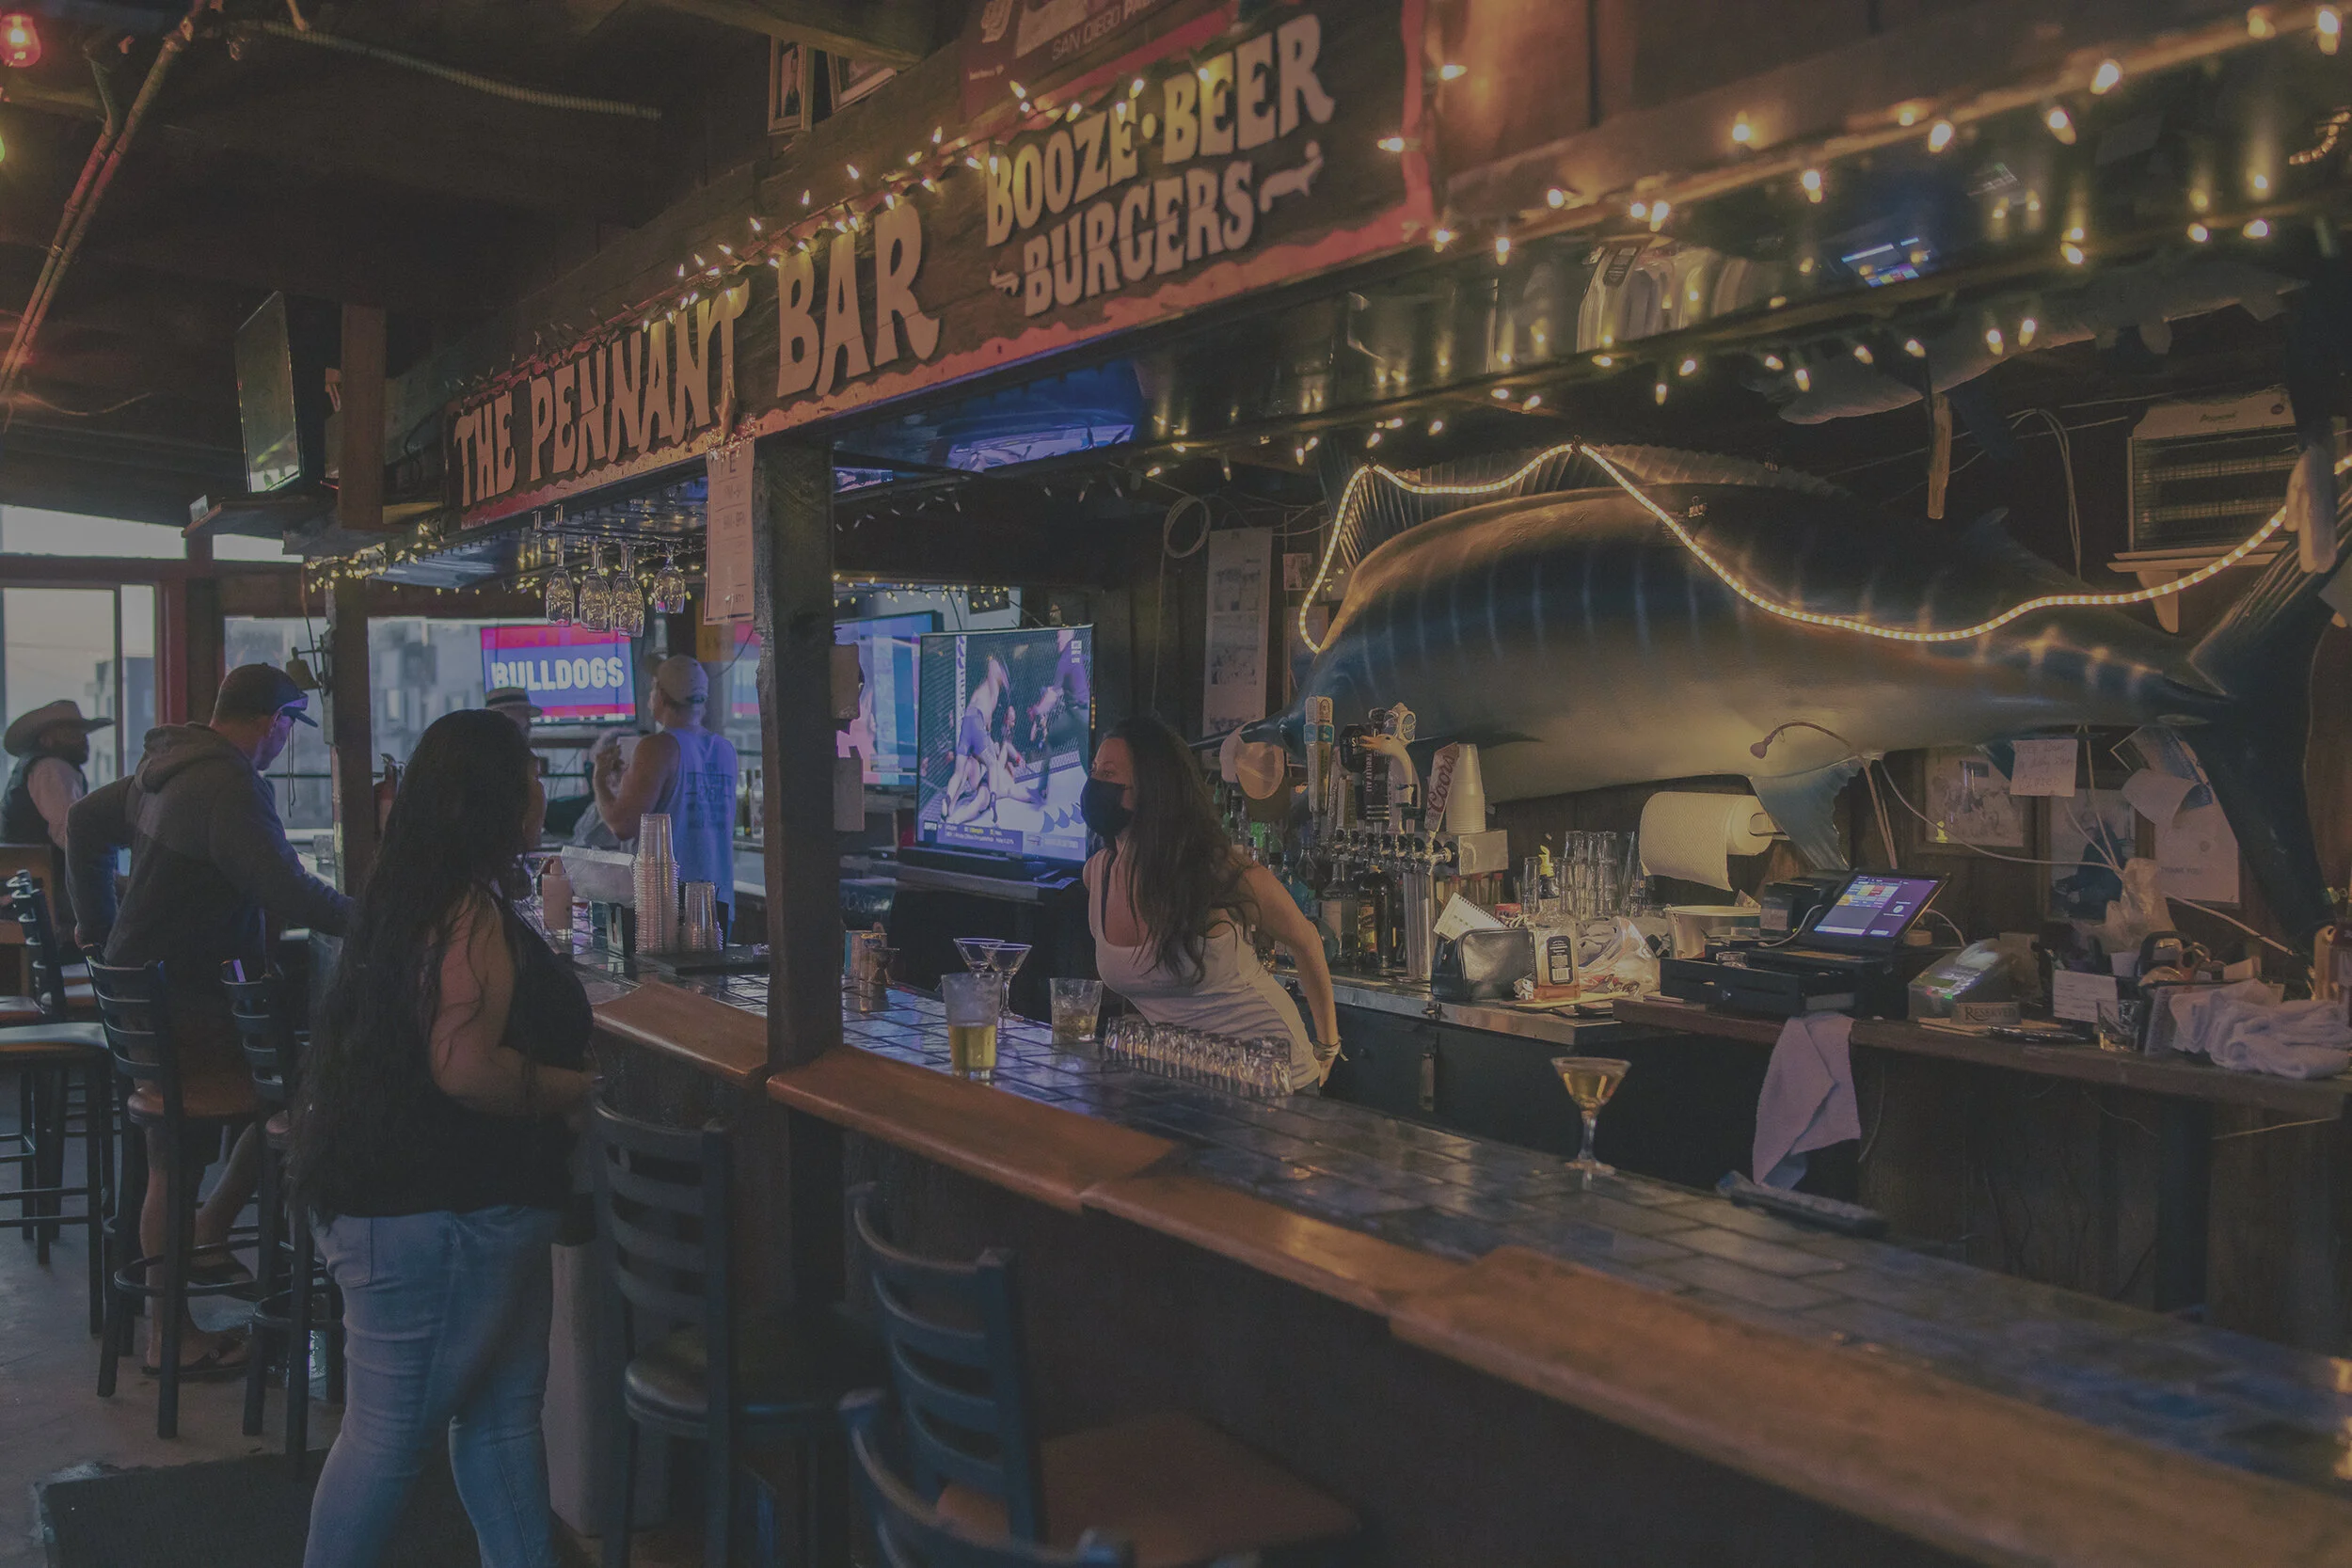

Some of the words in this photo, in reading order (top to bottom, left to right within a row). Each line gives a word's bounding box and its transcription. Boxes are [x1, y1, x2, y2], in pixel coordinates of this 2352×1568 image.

[1051, 29, 1081, 62] SAN
[1083, 4, 1121, 43] DIEGO
[986, 95, 1138, 247] BOOZE
[1163, 14, 1335, 165] BEER
[1024, 160, 1255, 317] BURGERS
[454, 390, 516, 507] THE
[529, 277, 750, 483] PENNANT
[776, 201, 940, 399] BAR
[490, 657, 625, 691] BULLDOGS
[1427, 754, 1455, 813] Coors
[1963, 1006, 2017, 1022] RESERVED
